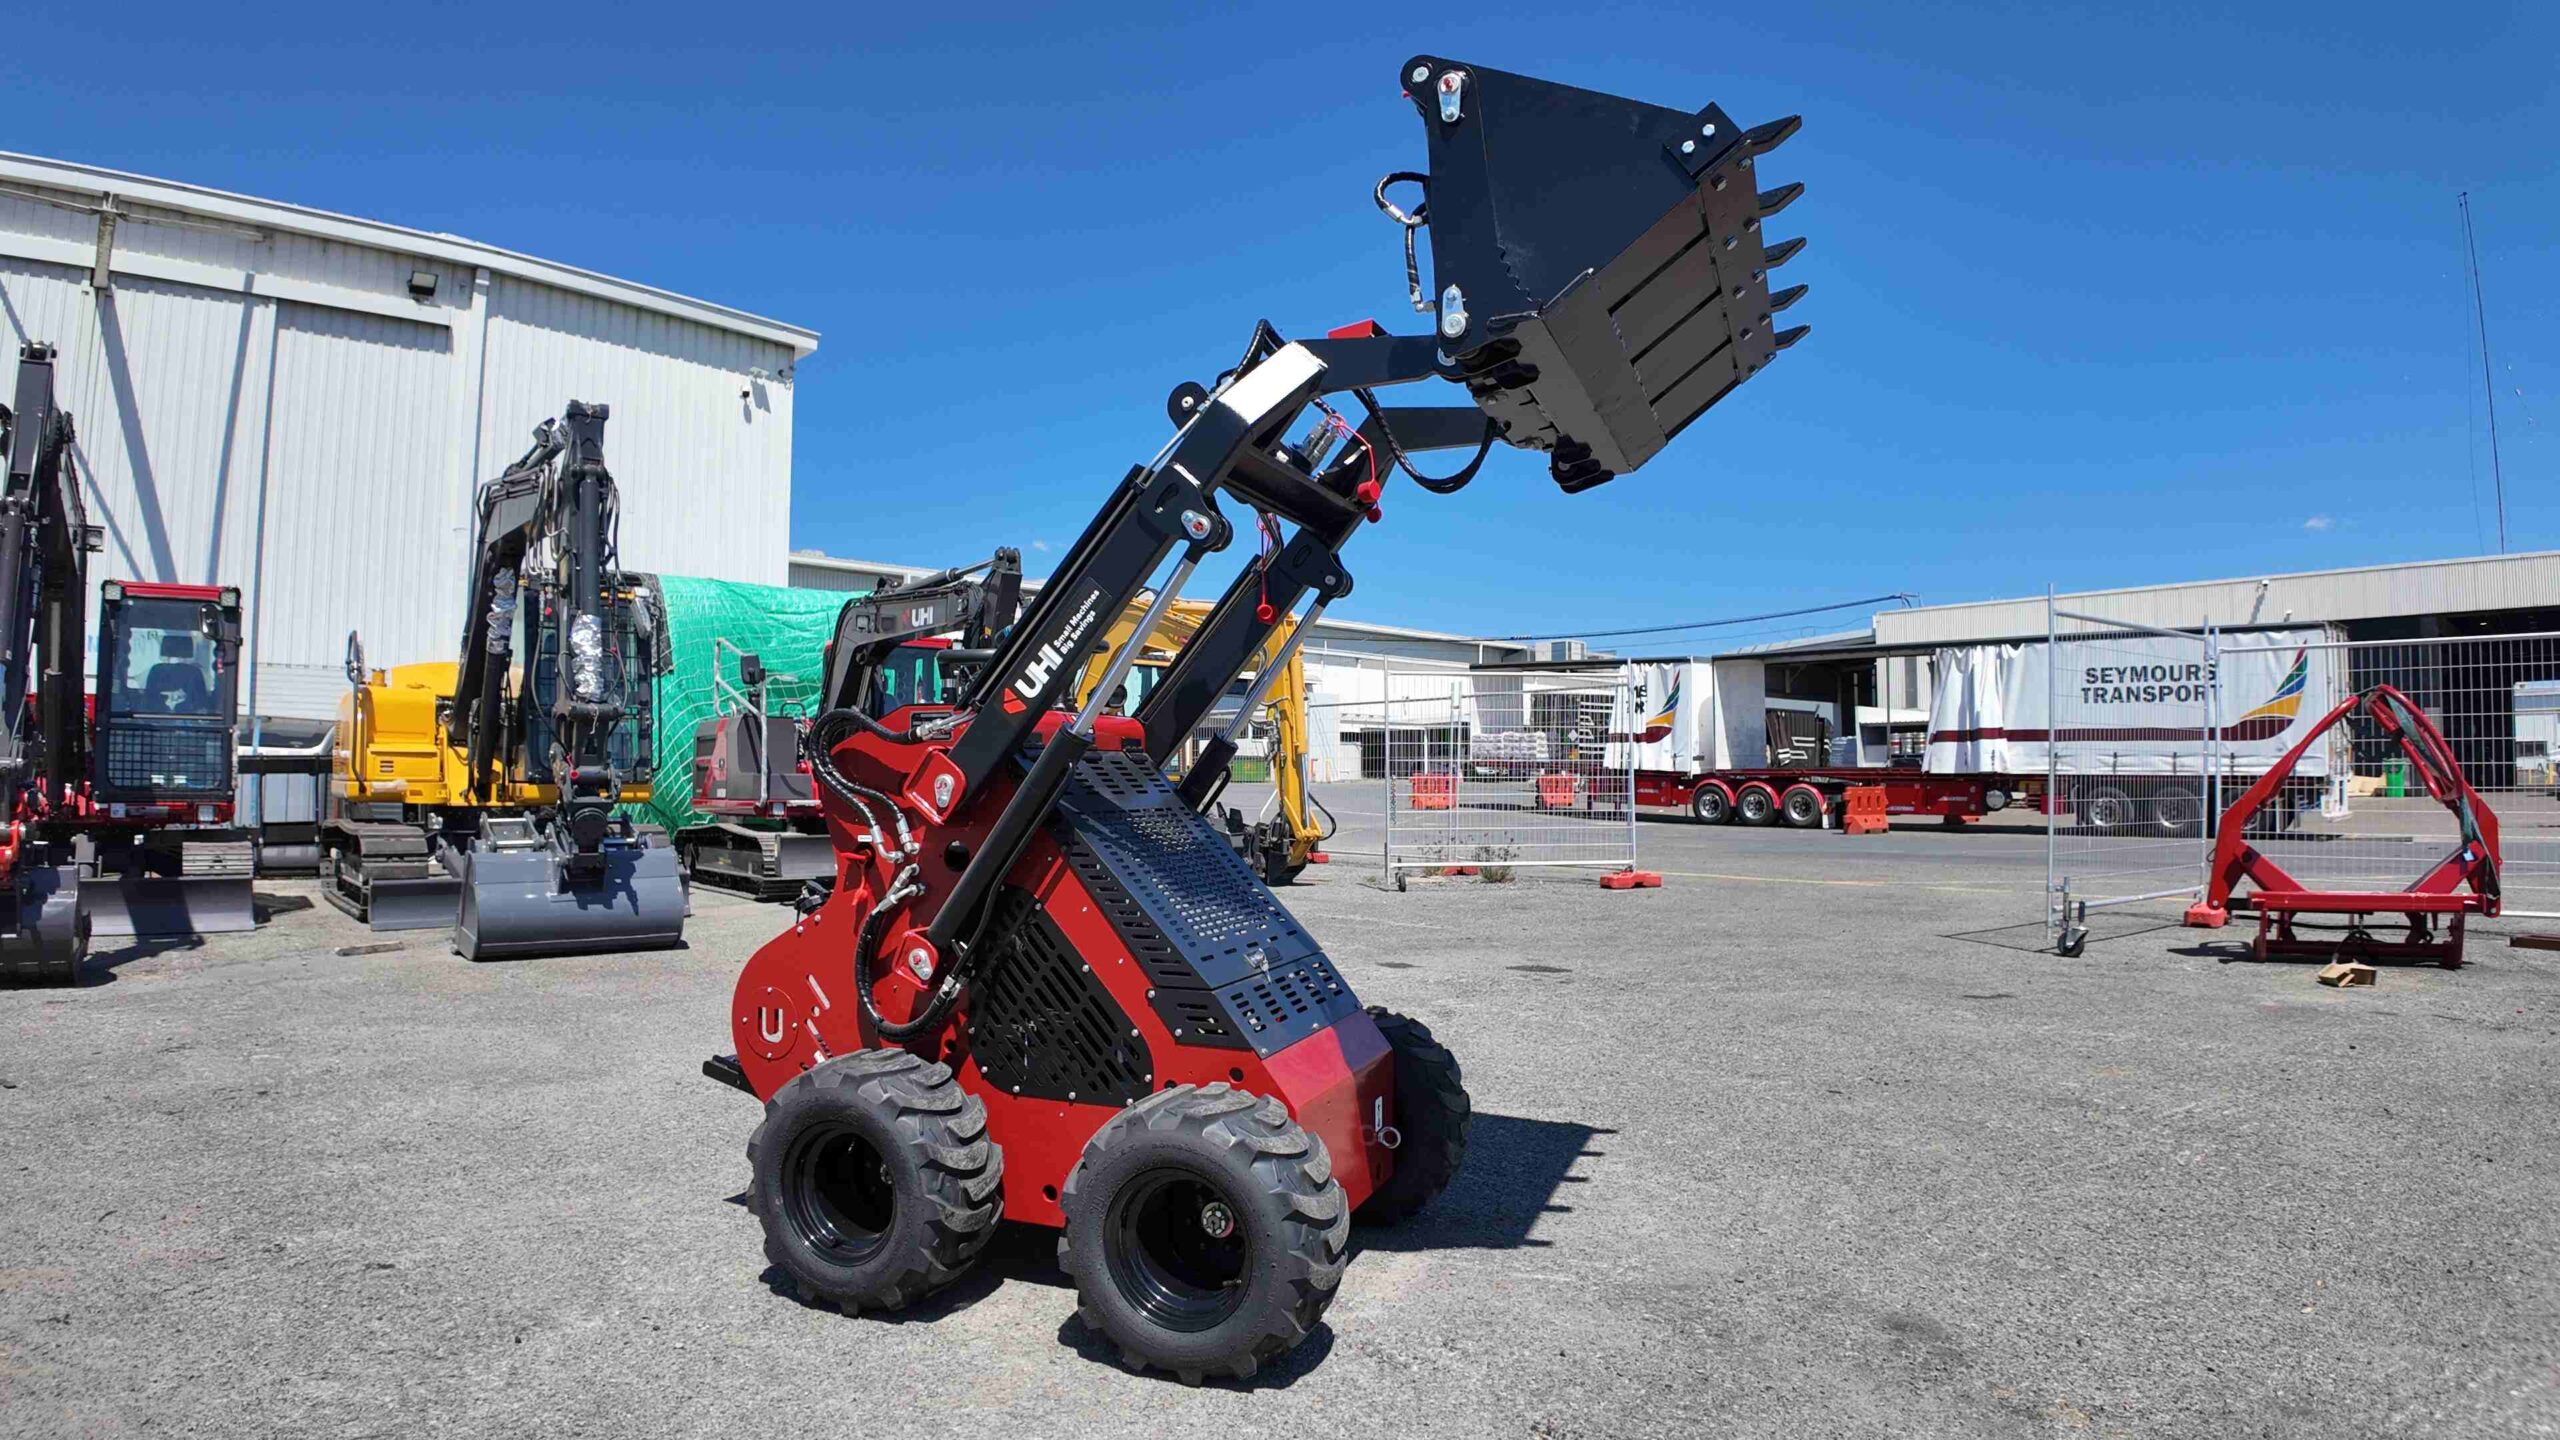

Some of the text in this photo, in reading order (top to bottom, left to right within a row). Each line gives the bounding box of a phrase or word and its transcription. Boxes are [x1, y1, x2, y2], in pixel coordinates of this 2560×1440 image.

[911, 606, 934, 628] UHI
[1053, 589, 1100, 649] Small Machines
[1059, 610, 1097, 655] Big Savings
[1014, 643, 1064, 699] UHI
[2085, 663, 2217, 685] SEYMOURS
[758, 1006, 784, 1043] U
